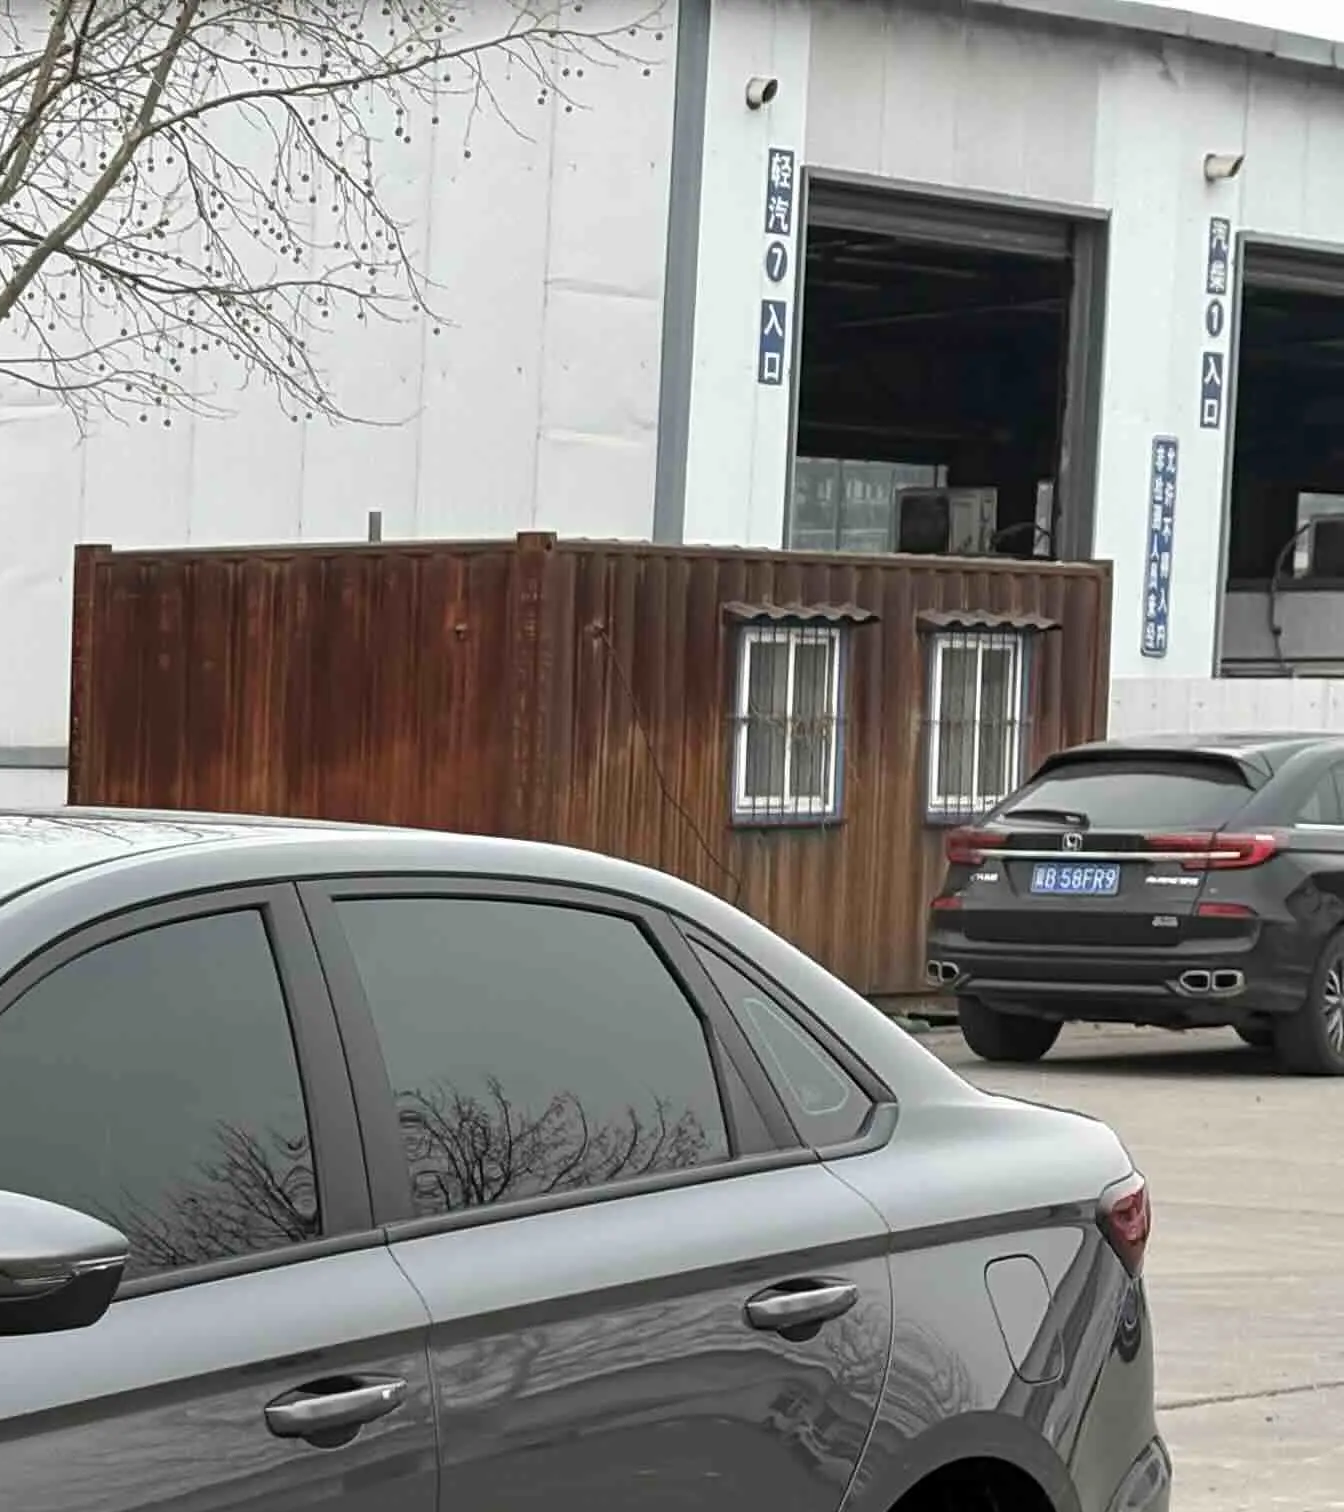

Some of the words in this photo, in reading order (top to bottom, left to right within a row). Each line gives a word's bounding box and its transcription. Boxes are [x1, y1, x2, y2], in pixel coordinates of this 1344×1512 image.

[767, 152, 792, 233] 轻汽
[763, 303, 784, 381] 入口
[1203, 355, 1221, 425] 入口
